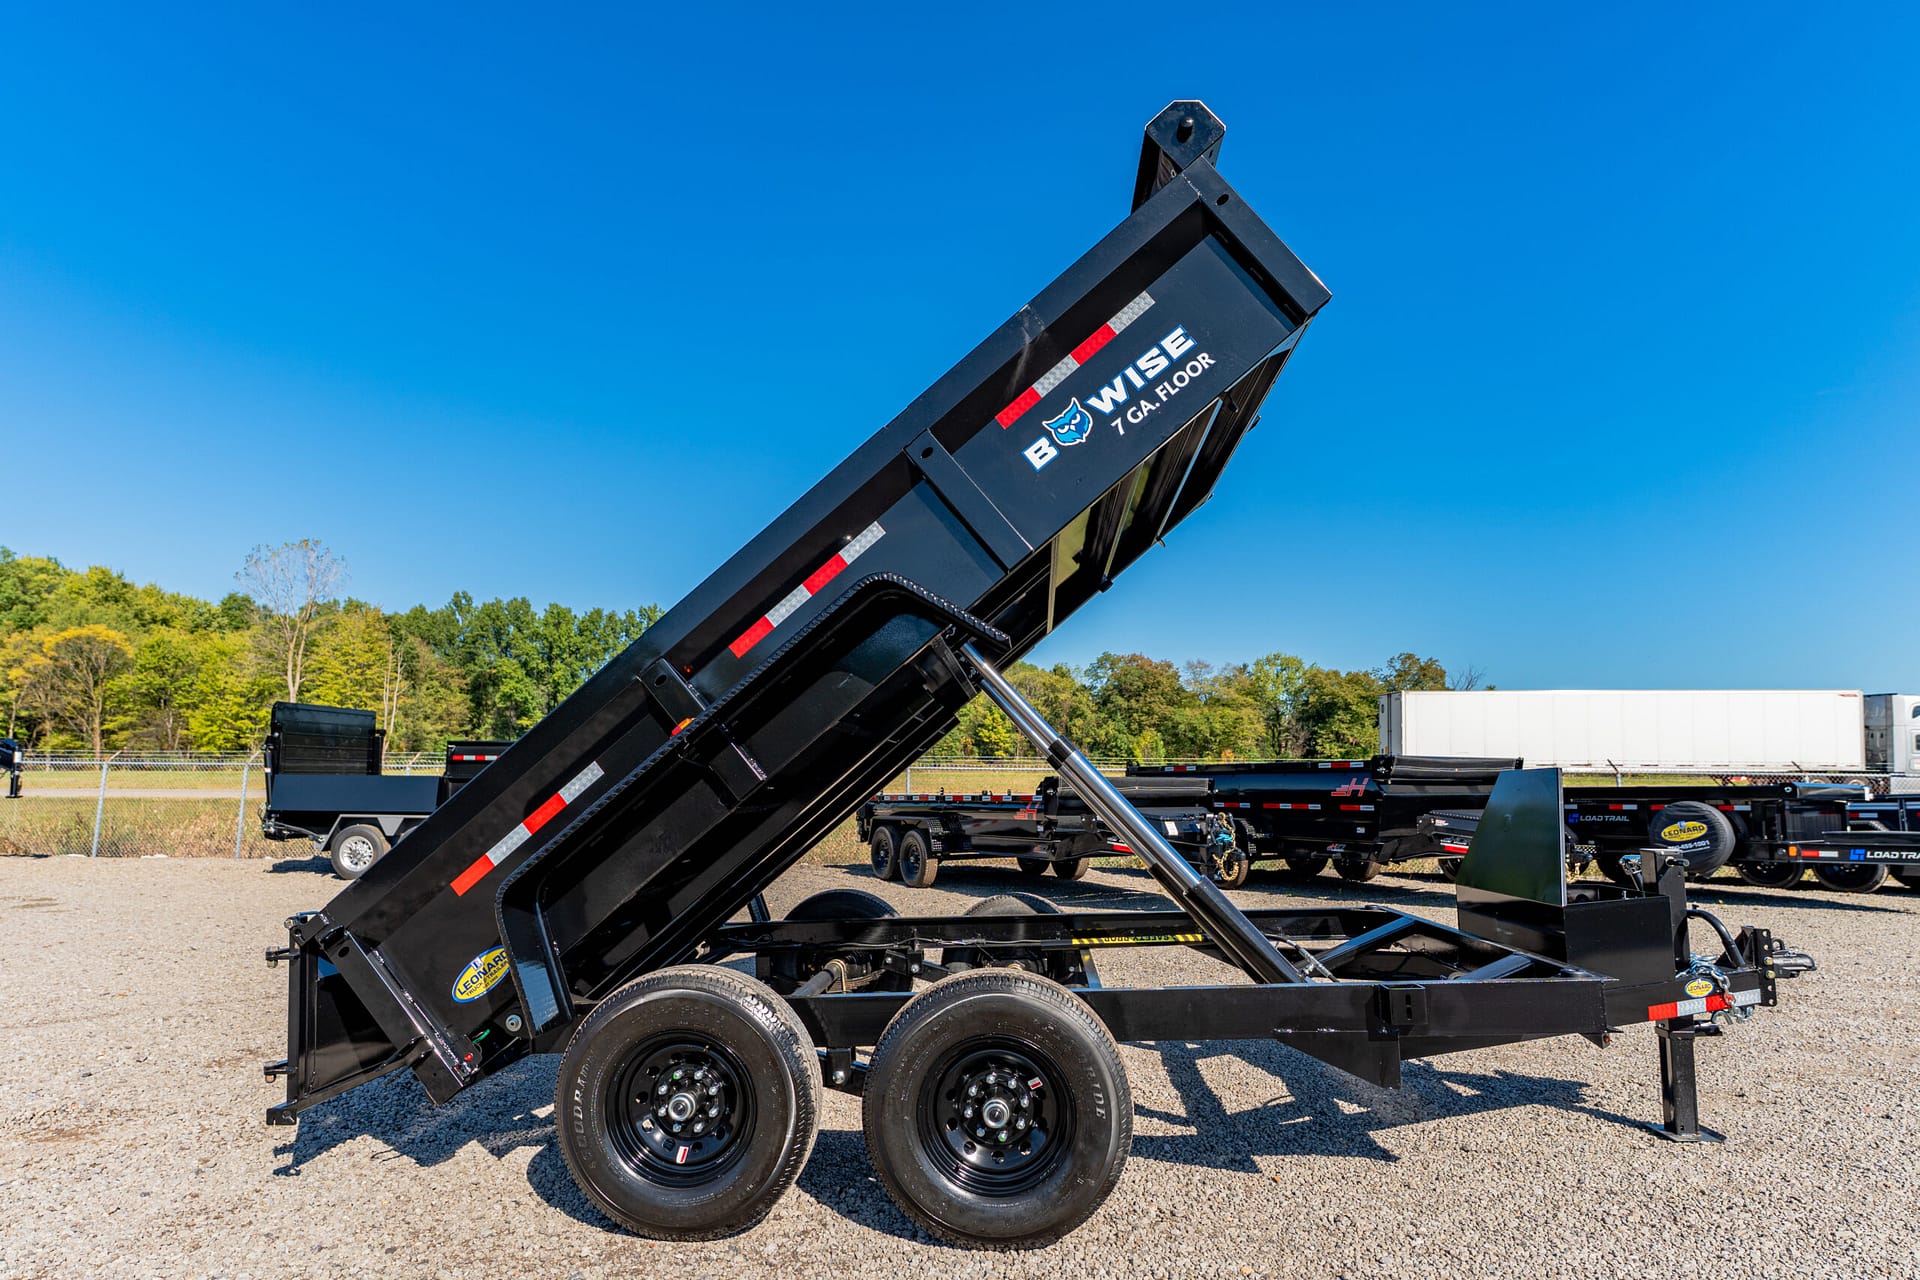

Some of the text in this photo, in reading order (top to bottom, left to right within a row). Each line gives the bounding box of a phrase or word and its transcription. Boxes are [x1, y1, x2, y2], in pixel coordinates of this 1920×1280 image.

[1110, 352, 1217, 436] 7 GA. FLOOR
[1662, 824, 1705, 837] LEONARD
[1866, 850, 1900, 859] LOAD
[457, 949, 508, 996] LEONARD
